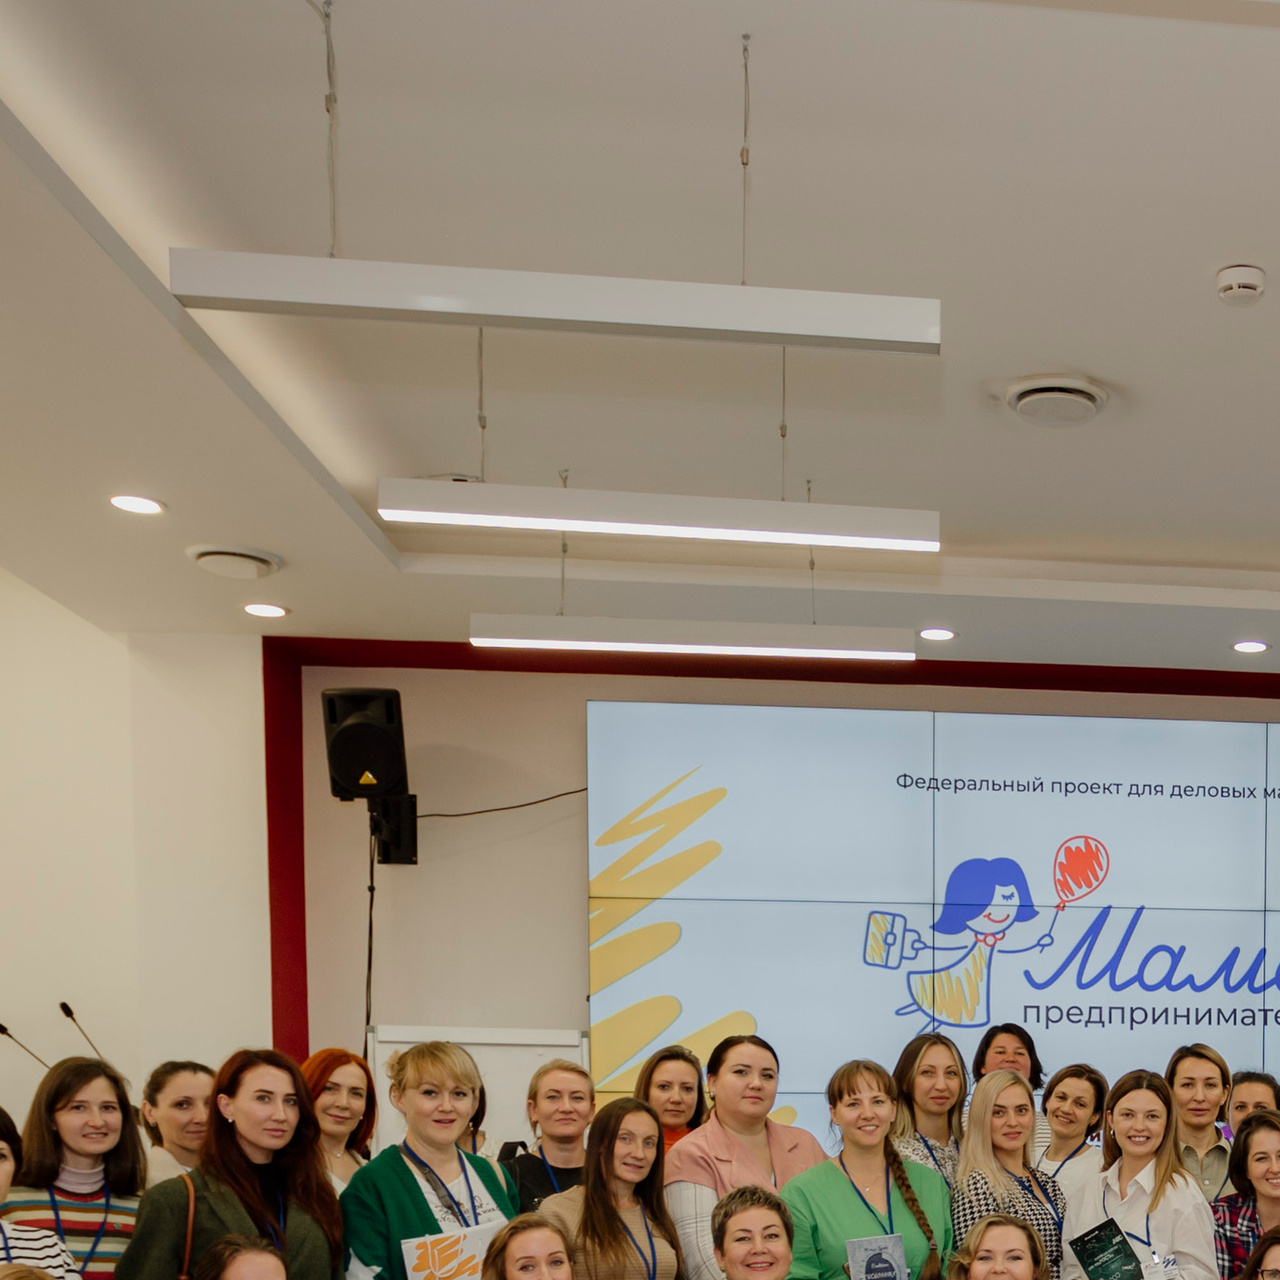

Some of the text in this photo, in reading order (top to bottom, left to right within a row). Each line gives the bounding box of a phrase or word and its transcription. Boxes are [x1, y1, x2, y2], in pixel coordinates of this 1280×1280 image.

[896, 773, 1044, 794] Федеральный
[1050, 780, 1123, 797] проект
[1127, 782, 1165, 797] для
[1170, 783, 1258, 800] деловых
